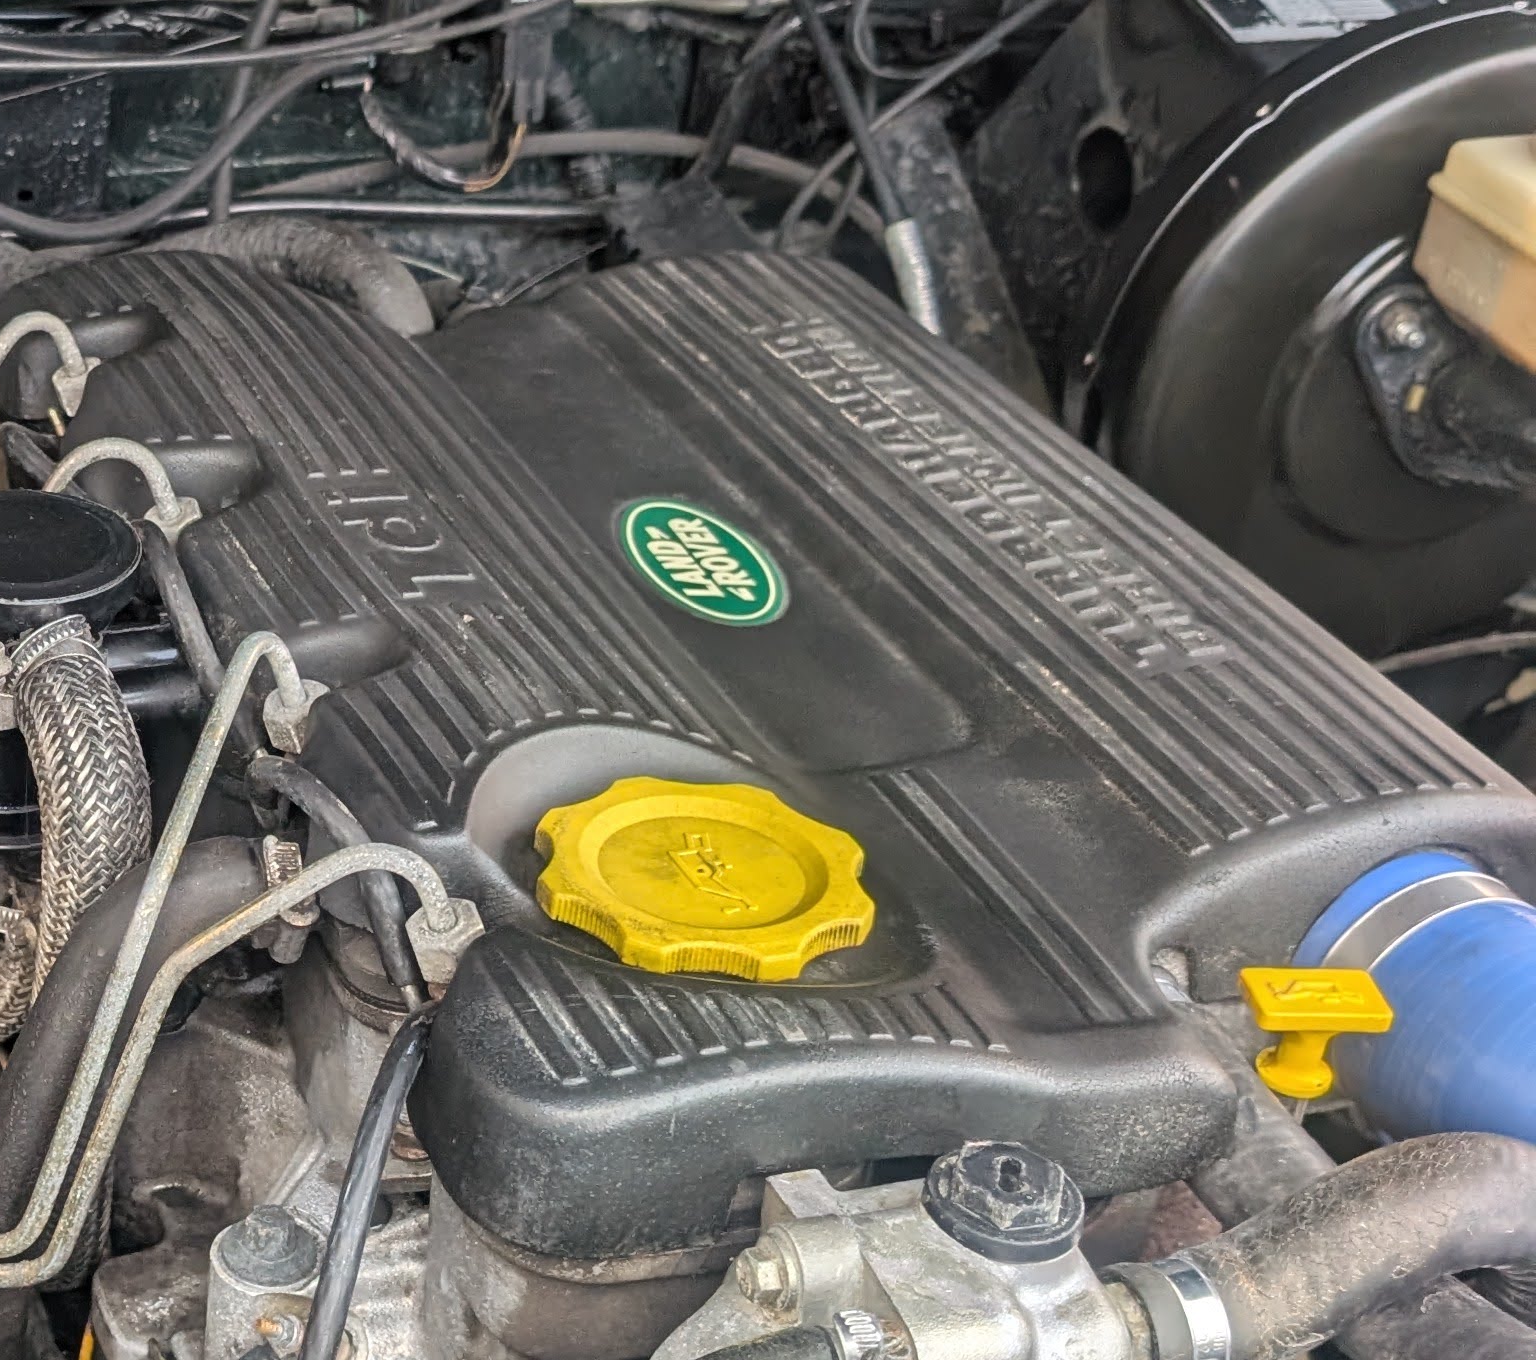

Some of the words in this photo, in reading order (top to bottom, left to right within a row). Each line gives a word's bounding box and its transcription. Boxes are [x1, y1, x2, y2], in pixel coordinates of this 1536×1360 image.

[806, 323, 1042, 506] INJECTION
[645, 538, 727, 599] LAND
[667, 517, 758, 589] ROVER
[761, 336, 1165, 669] TURBOCHARGED
[1017, 508, 1227, 659] DIRECT
